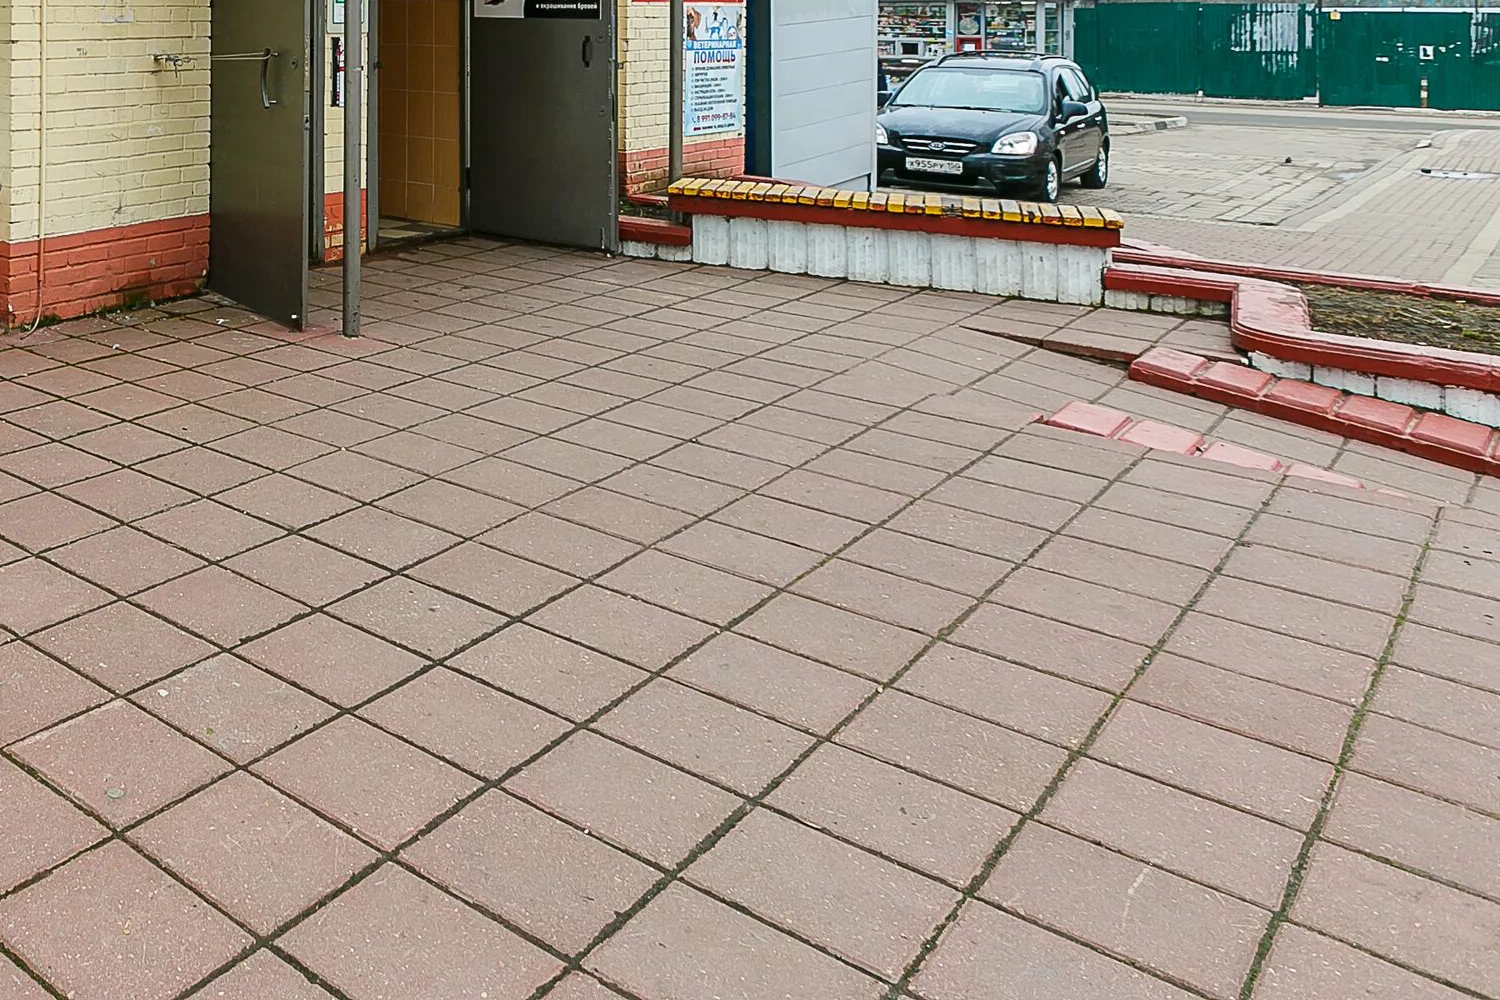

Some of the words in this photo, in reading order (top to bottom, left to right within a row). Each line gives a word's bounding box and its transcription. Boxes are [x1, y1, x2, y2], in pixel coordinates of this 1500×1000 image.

[577, 2, 598, 10] бровей
[693, 40, 737, 49] ВЕТЕРИНАРНАЯ
[693, 50, 736, 64] ПОМОЩЬ
